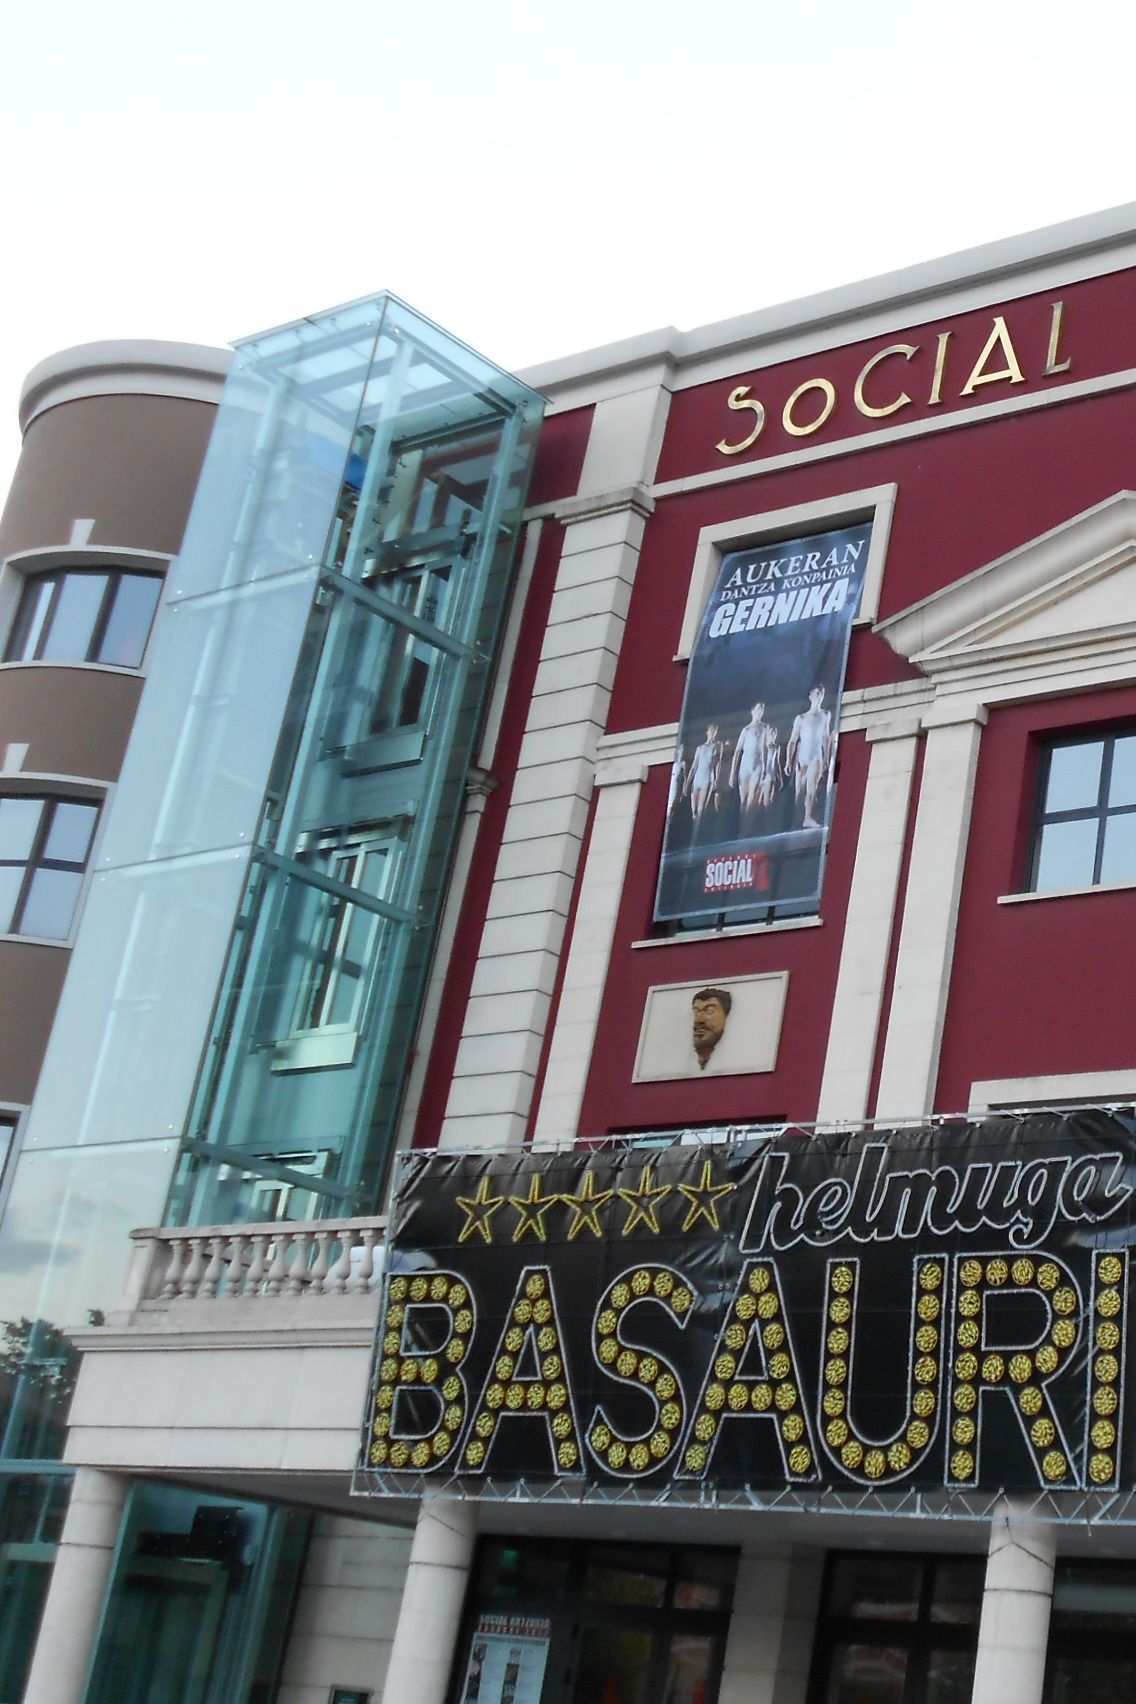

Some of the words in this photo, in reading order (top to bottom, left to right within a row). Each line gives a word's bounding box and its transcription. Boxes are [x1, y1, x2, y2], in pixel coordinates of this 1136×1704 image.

[716, 301, 1072, 455] SOCIAL
[720, 582, 775, 602] DANTZA
[782, 563, 856, 589] KONPAINIA
[724, 540, 865, 588] AUKERAN
[709, 577, 849, 638] GERNIKA
[705, 859, 752, 887] SOCIAL
[739, 1142, 1132, 1252] helmuga
[364, 1249, 1129, 1492] BASAURI
